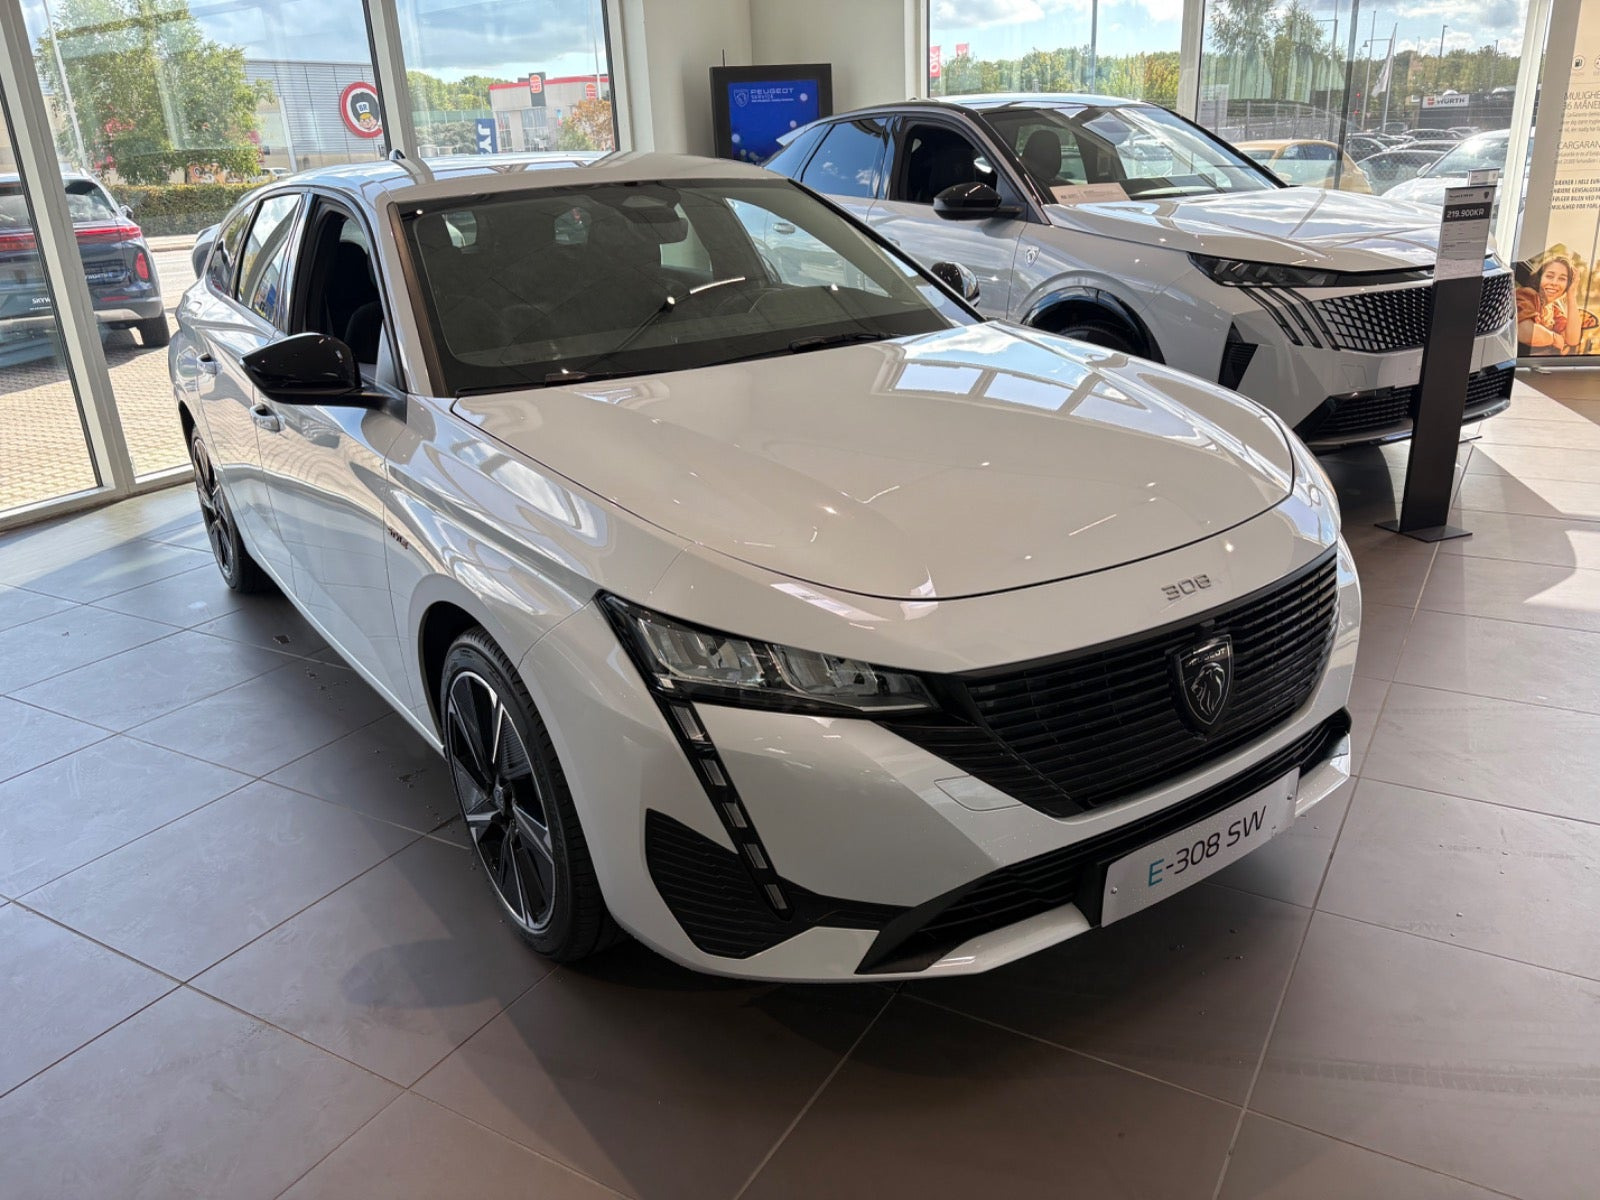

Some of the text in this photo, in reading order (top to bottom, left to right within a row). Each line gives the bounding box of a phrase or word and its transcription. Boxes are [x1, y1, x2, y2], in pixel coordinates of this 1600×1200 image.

[477, 124, 493, 153] JY
[1446, 207, 1485, 218] 219.900KR
[1161, 574, 1212, 601] 308
[1148, 805, 1267, 888] E-308 SW
